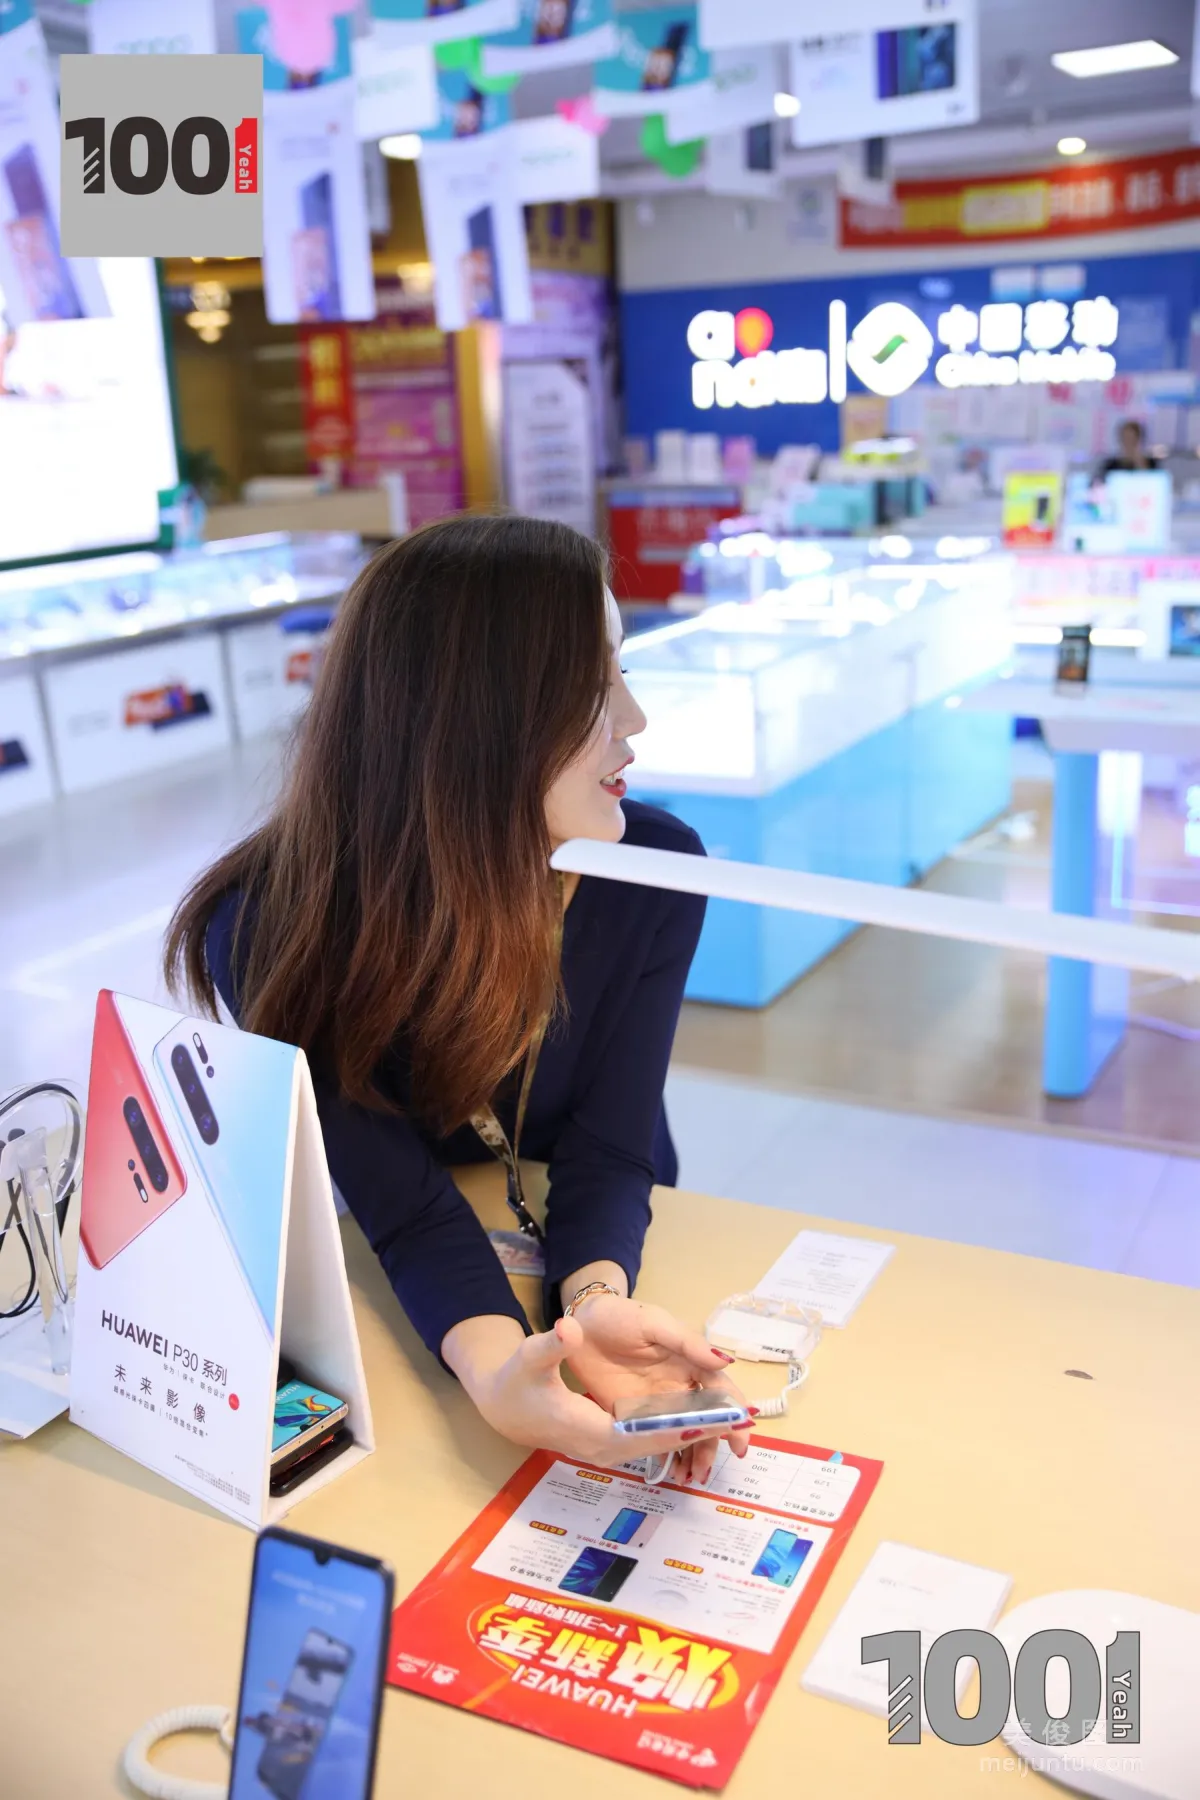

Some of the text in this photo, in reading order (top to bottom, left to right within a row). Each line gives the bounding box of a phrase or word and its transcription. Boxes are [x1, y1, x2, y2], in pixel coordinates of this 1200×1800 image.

[101, 1310, 228, 1386] HUAWEI P30 系列
[114, 1364, 206, 1424] 未来影像
[755, 1450, 778, 1460] 1560
[617, 1460, 647, 1473] 刷卡数
[749, 1463, 768, 1472] 900
[819, 1465, 837, 1474] 199
[742, 1476, 760, 1485] 780
[474, 1607, 733, 1714] 焕新季
[509, 1662, 640, 1719] HUAWEI
